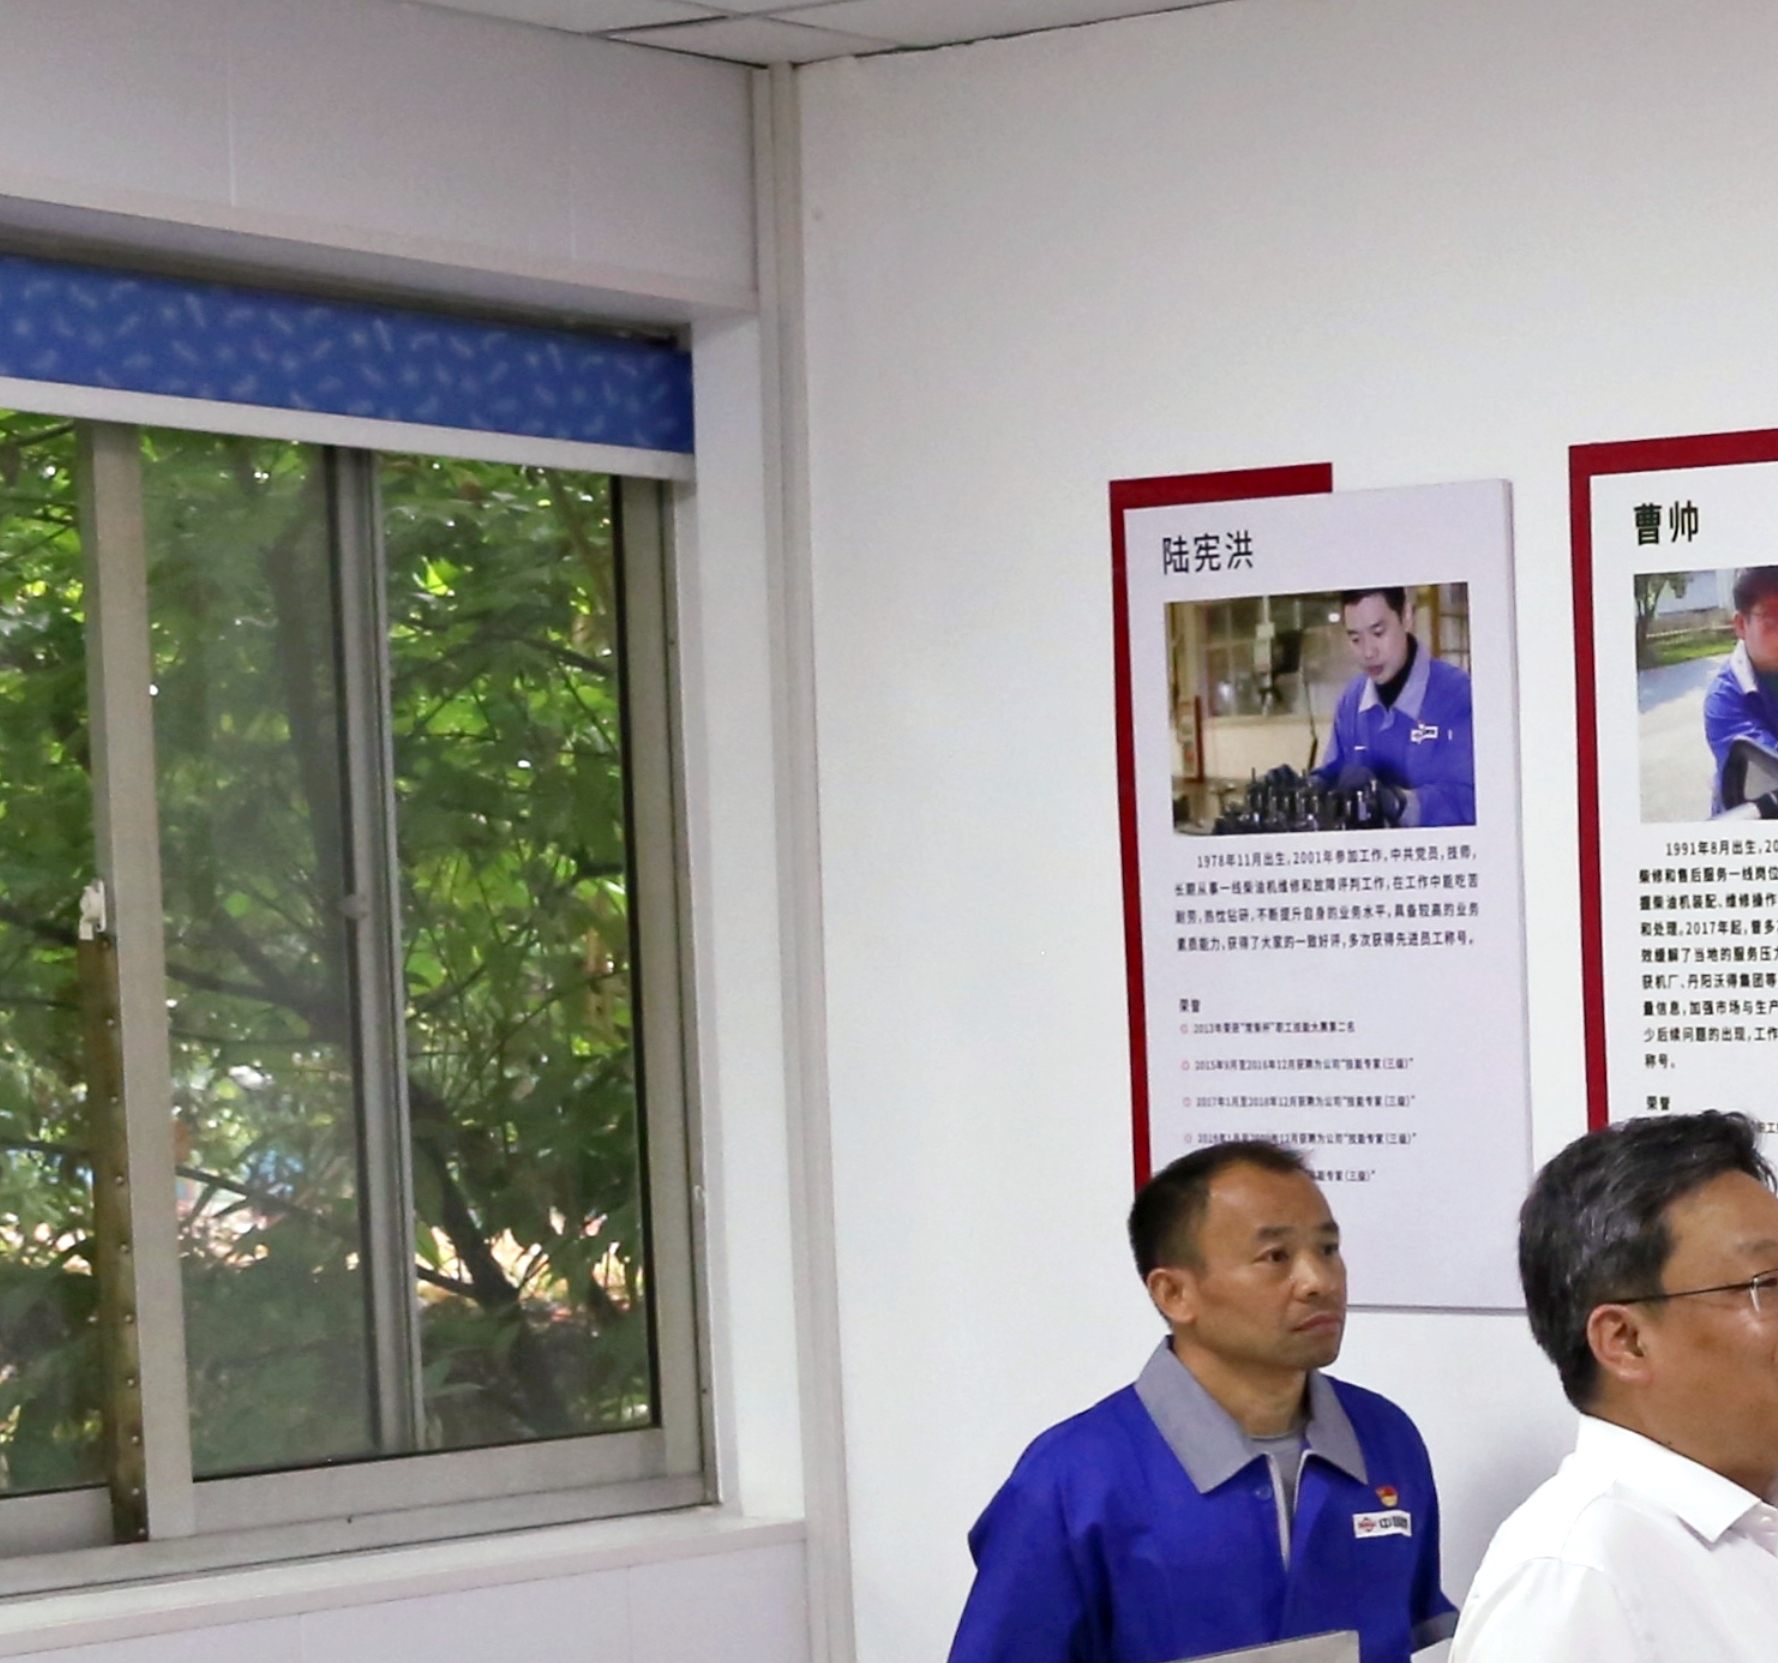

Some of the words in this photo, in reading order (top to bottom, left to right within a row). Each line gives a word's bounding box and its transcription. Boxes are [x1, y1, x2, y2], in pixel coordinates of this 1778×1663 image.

[1633, 500, 1700, 546] 曹帅
[1162, 529, 1254, 575] 陆宪洪
